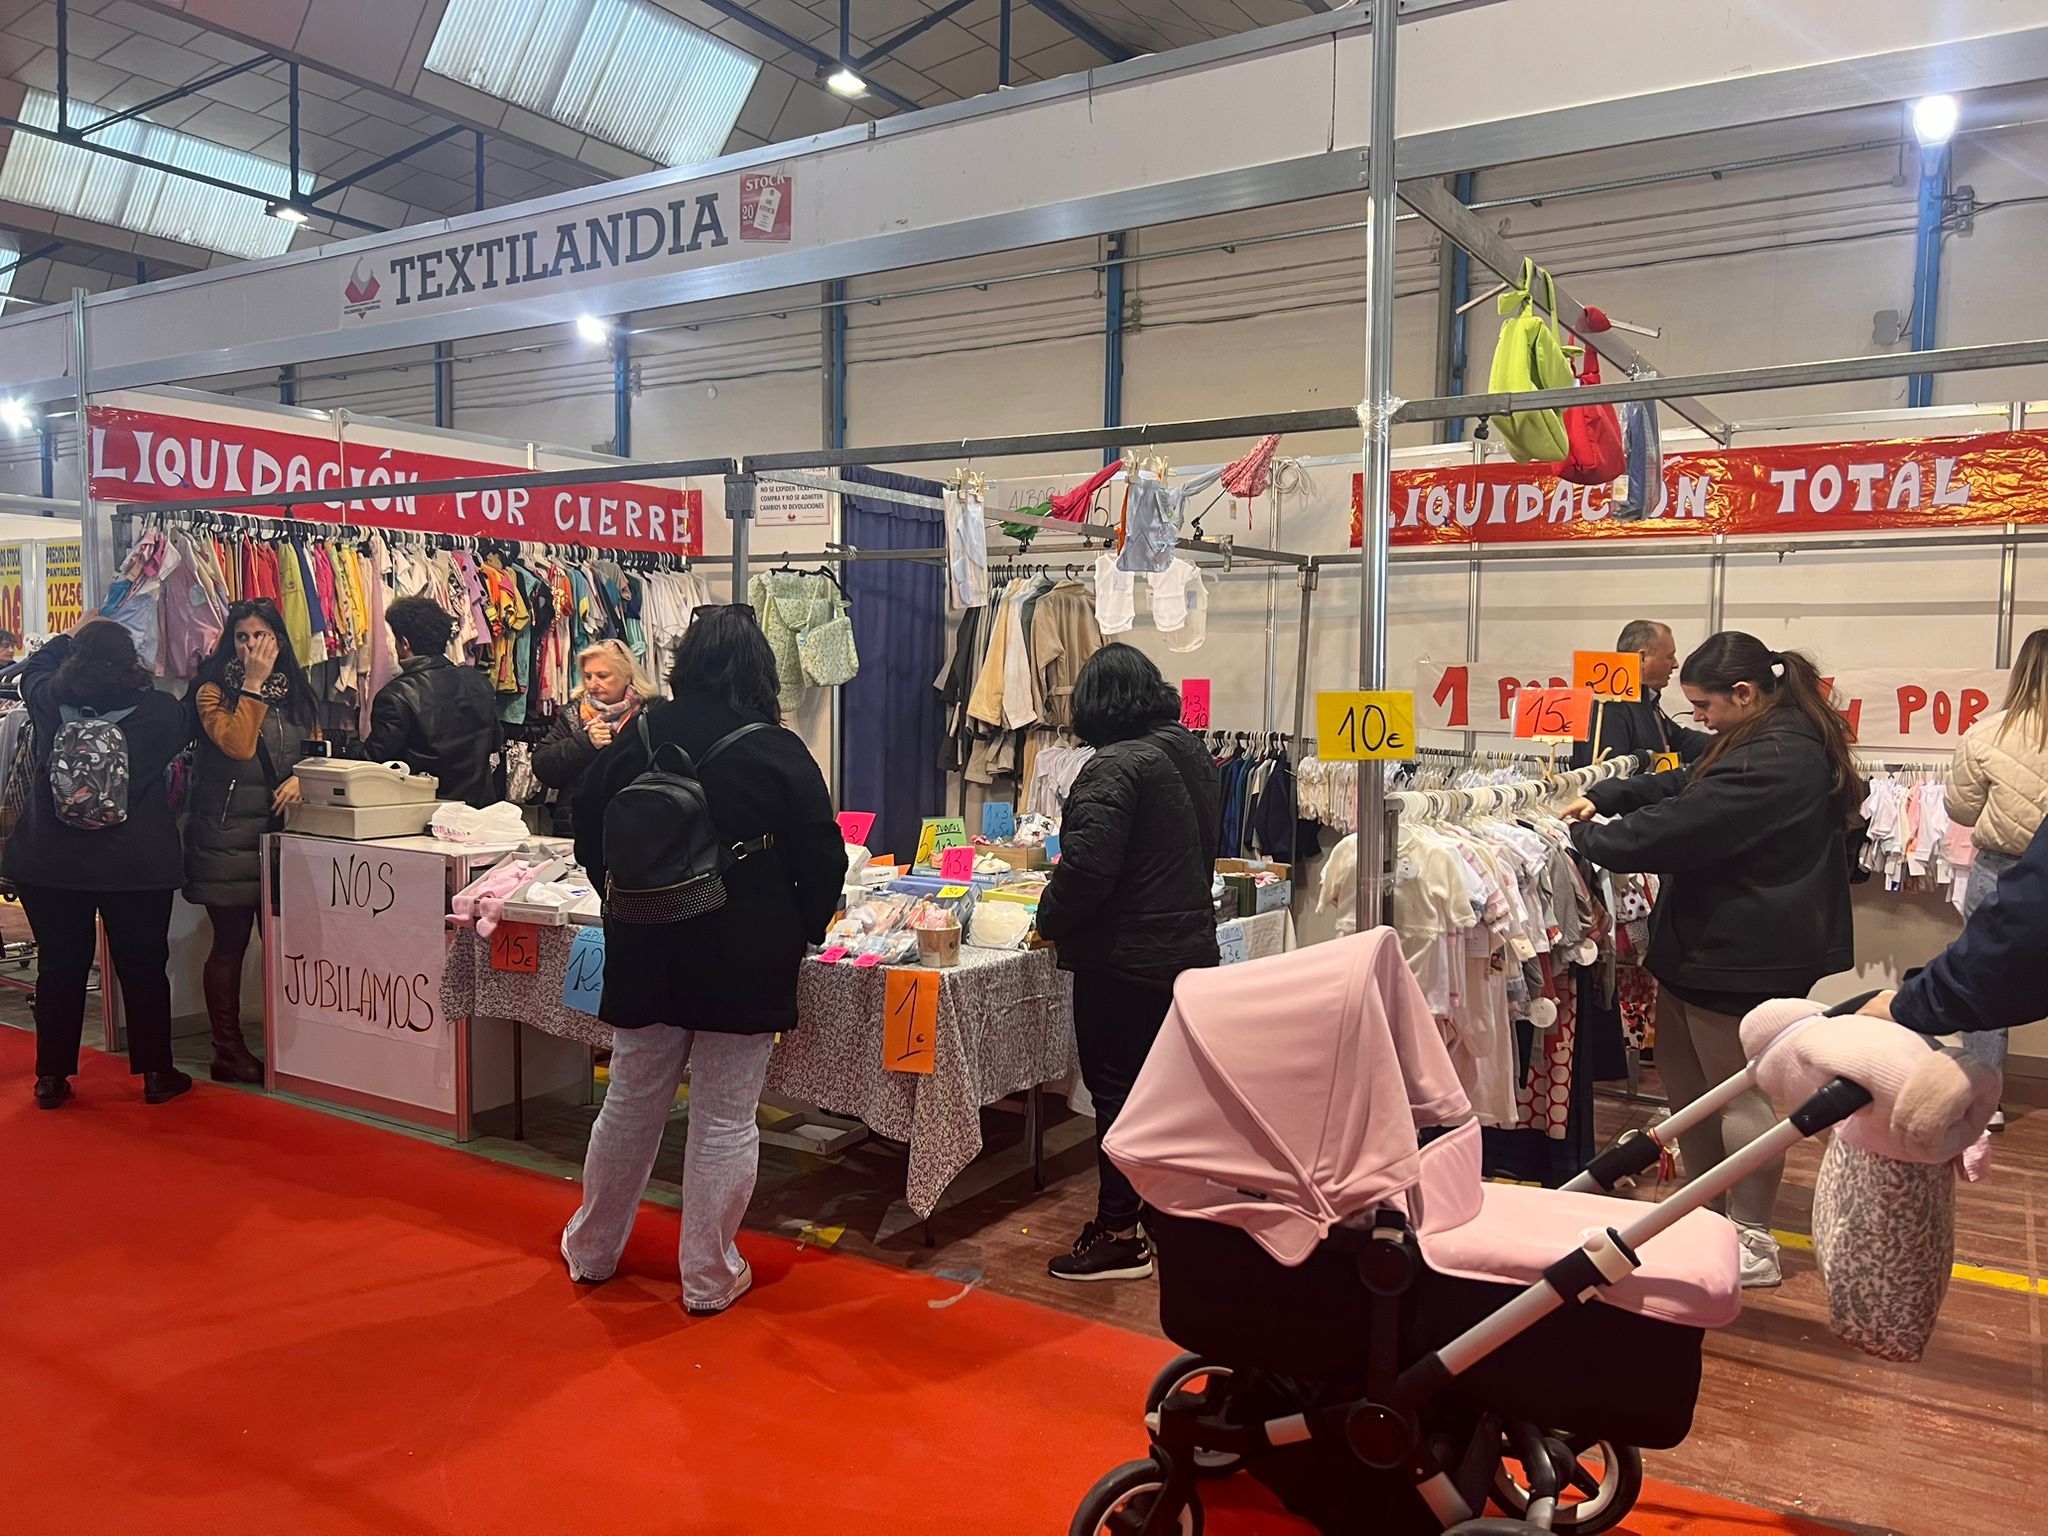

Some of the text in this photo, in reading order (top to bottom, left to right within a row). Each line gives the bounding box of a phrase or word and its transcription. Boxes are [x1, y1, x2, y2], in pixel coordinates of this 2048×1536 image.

[745, 175, 785, 191] STOCK
[390, 192, 729, 305] TEXTILANDIA
[92, 427, 692, 544] LIQUIDACIÓN POR CIERRE
[1770, 456, 1971, 514] TOTAL
[46, 566, 80, 577] PANTALONES
[48, 582, 82, 606] 1X25€
[1432, 666, 1469, 727] 1
[1585, 662, 1634, 697] 20€
[1337, 704, 1405, 753] 10€
[1525, 696, 1573, 734] 15€
[1896, 684, 1990, 736] POR
[331, 853, 395, 918] NOS
[499, 936, 534, 967] 15€
[284, 953, 434, 1033] JUBILAMOS
